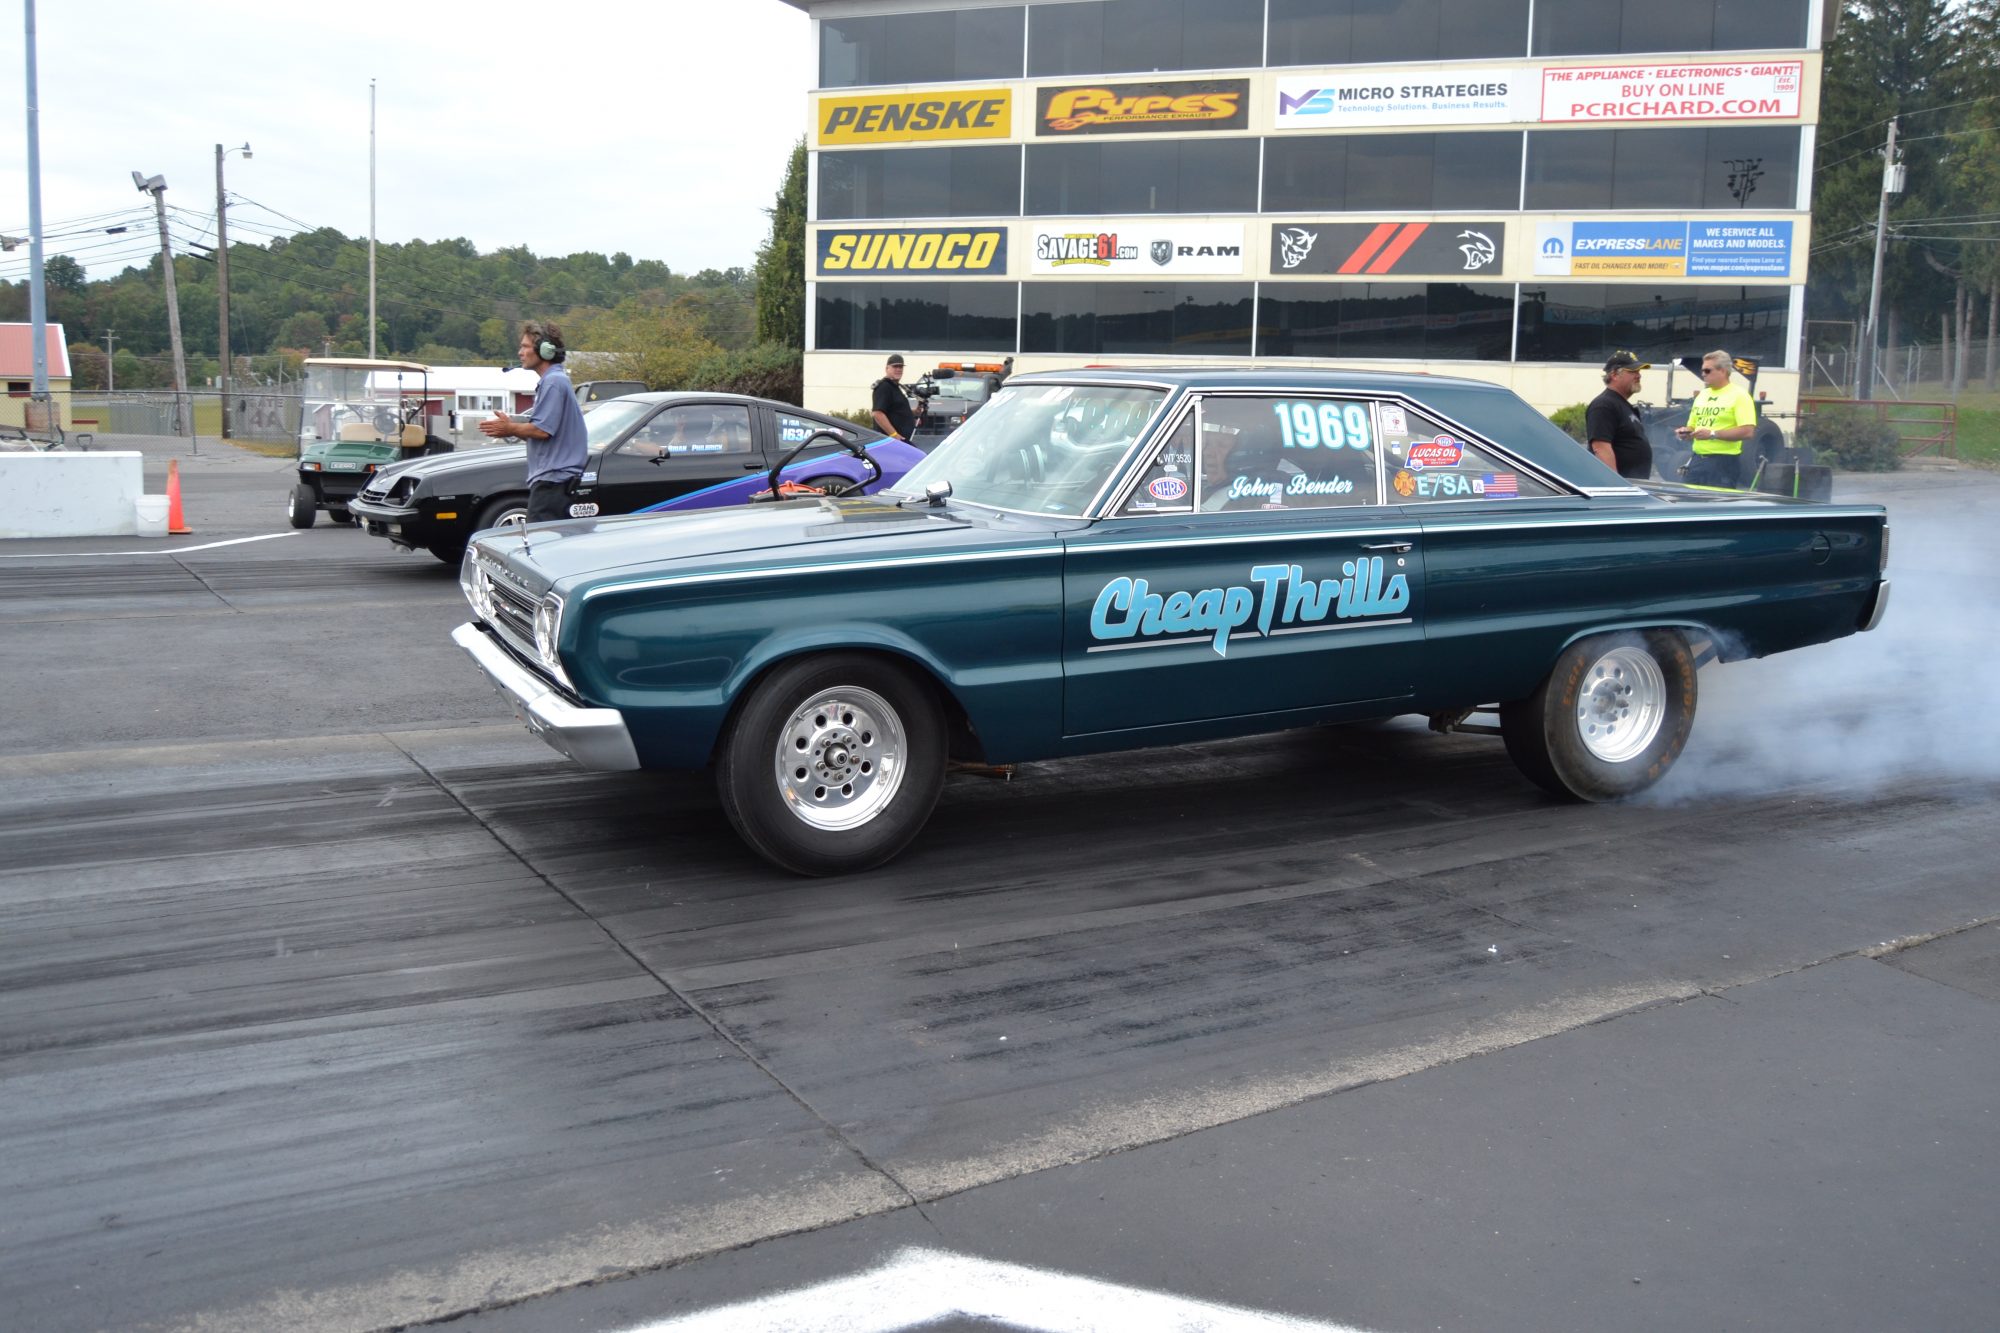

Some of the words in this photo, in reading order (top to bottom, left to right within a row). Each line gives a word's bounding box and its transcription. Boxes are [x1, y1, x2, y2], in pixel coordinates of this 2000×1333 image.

[1576, 70, 1645, 80] APPLIANCE
[1656, 67, 1742, 78] ELECTRONICS
[1339, 86, 1394, 101] MICRO
[1400, 83, 1508, 99] STRATEGIES
[1622, 84, 1655, 98] BUY
[1659, 83, 1684, 97] ON
[1689, 82, 1725, 96] LINE
[1338, 104, 1385, 113] Technology
[1432, 102, 1470, 110] Business
[1473, 101, 1508, 109] Results.
[1571, 99, 1780, 117] PCRICHARD.COM
[823, 99, 1006, 135] PENSKE
[1706, 228, 1720, 237] WE
[1722, 228, 1757, 237] SERVICE
[1759, 228, 1775, 237] ALL
[823, 233, 1000, 269] SUNOCO
[1693, 239, 1724, 248] MAKES
[1726, 239, 1745, 248] AND
[1747, 239, 1786, 248] MODELS.
[1177, 246, 1240, 257] RAM
[1274, 401, 1371, 450] 1969
[782, 427, 813, 441] 1634
[1163, 453, 1175, 463] WT
[1176, 454, 1192, 463] 3520
[1412, 448, 1442, 458] LUCAS
[1442, 448, 1457, 457] OIL
[1153, 481, 1183, 496] NHRA
[1228, 475, 1277, 500] John
[1286, 473, 1353, 496] Bender
[1416, 474, 1472, 496] E/SA
[573, 504, 596, 512] STAHL
[1090, 576, 1255, 658] Cheap
[1250, 556, 1411, 637] Thrills
